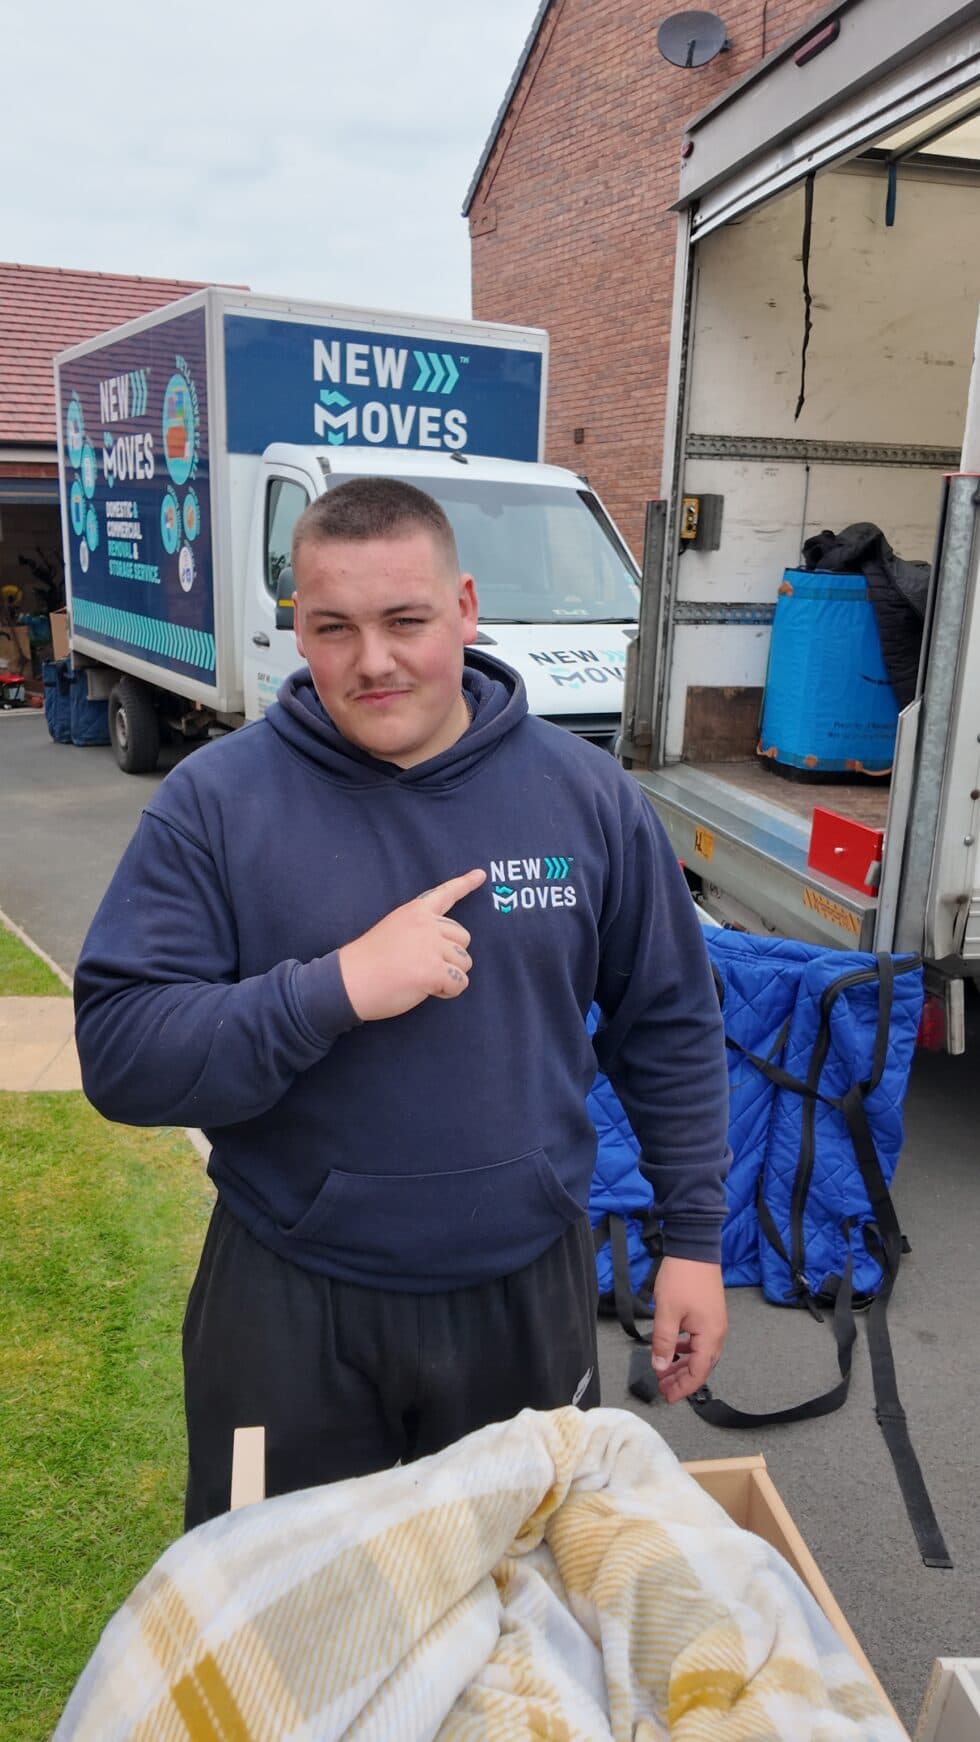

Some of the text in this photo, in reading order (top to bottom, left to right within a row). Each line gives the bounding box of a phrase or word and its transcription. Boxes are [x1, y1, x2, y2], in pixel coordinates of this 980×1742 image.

[313, 339, 408, 389] NEW
[100, 373, 129, 424] NEW
[313, 401, 468, 449] MOVES
[103, 433, 154, 481] MOVES
[528, 650, 600, 666] NEW
[550, 667, 626, 686] MOV
[490, 858, 540, 882] NEW
[492, 886, 576, 911] MOVES
